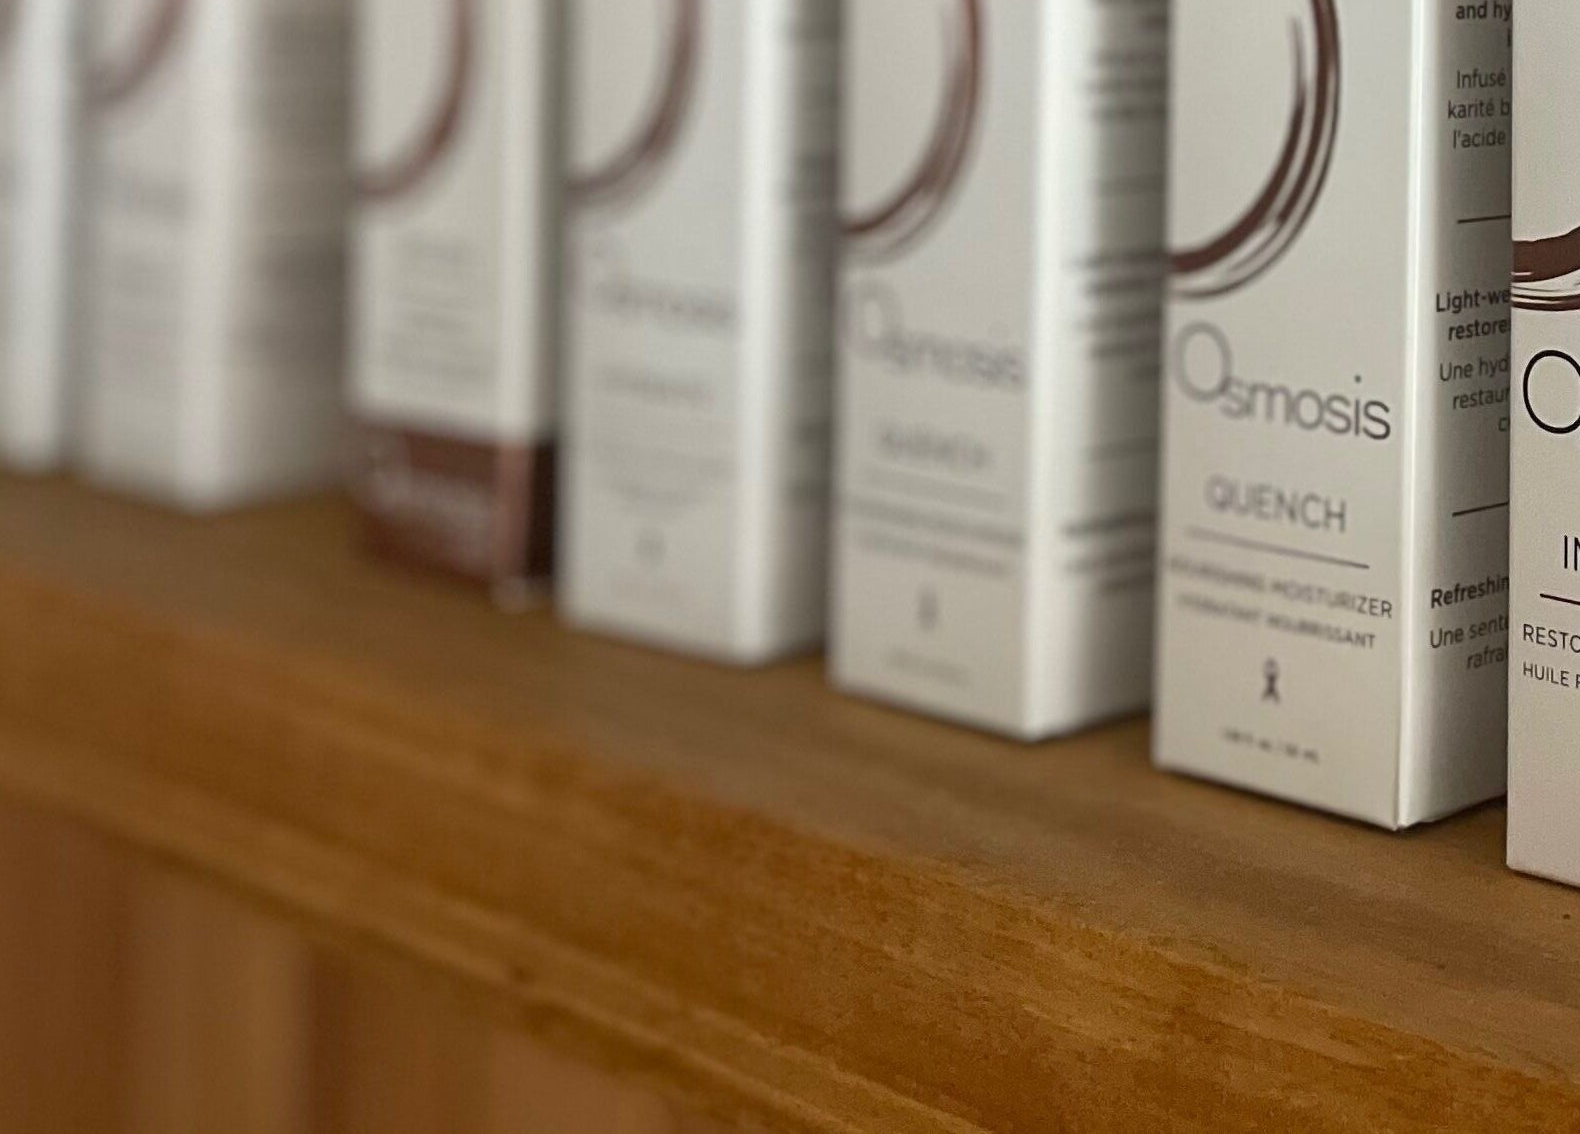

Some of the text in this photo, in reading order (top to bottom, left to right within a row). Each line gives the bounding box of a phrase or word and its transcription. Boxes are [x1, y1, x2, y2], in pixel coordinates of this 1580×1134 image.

[1456, 0, 1488, 20] and
[1456, 67, 1507, 89] Infusé
[1447, 98, 1496, 119] karité
[1174, 321, 1392, 441] Osmosis
[1440, 361, 1473, 382] Une
[1204, 473, 1347, 533] QUENCH
[1430, 627, 1464, 649] Une
[1522, 661, 1570, 687] HUILE
